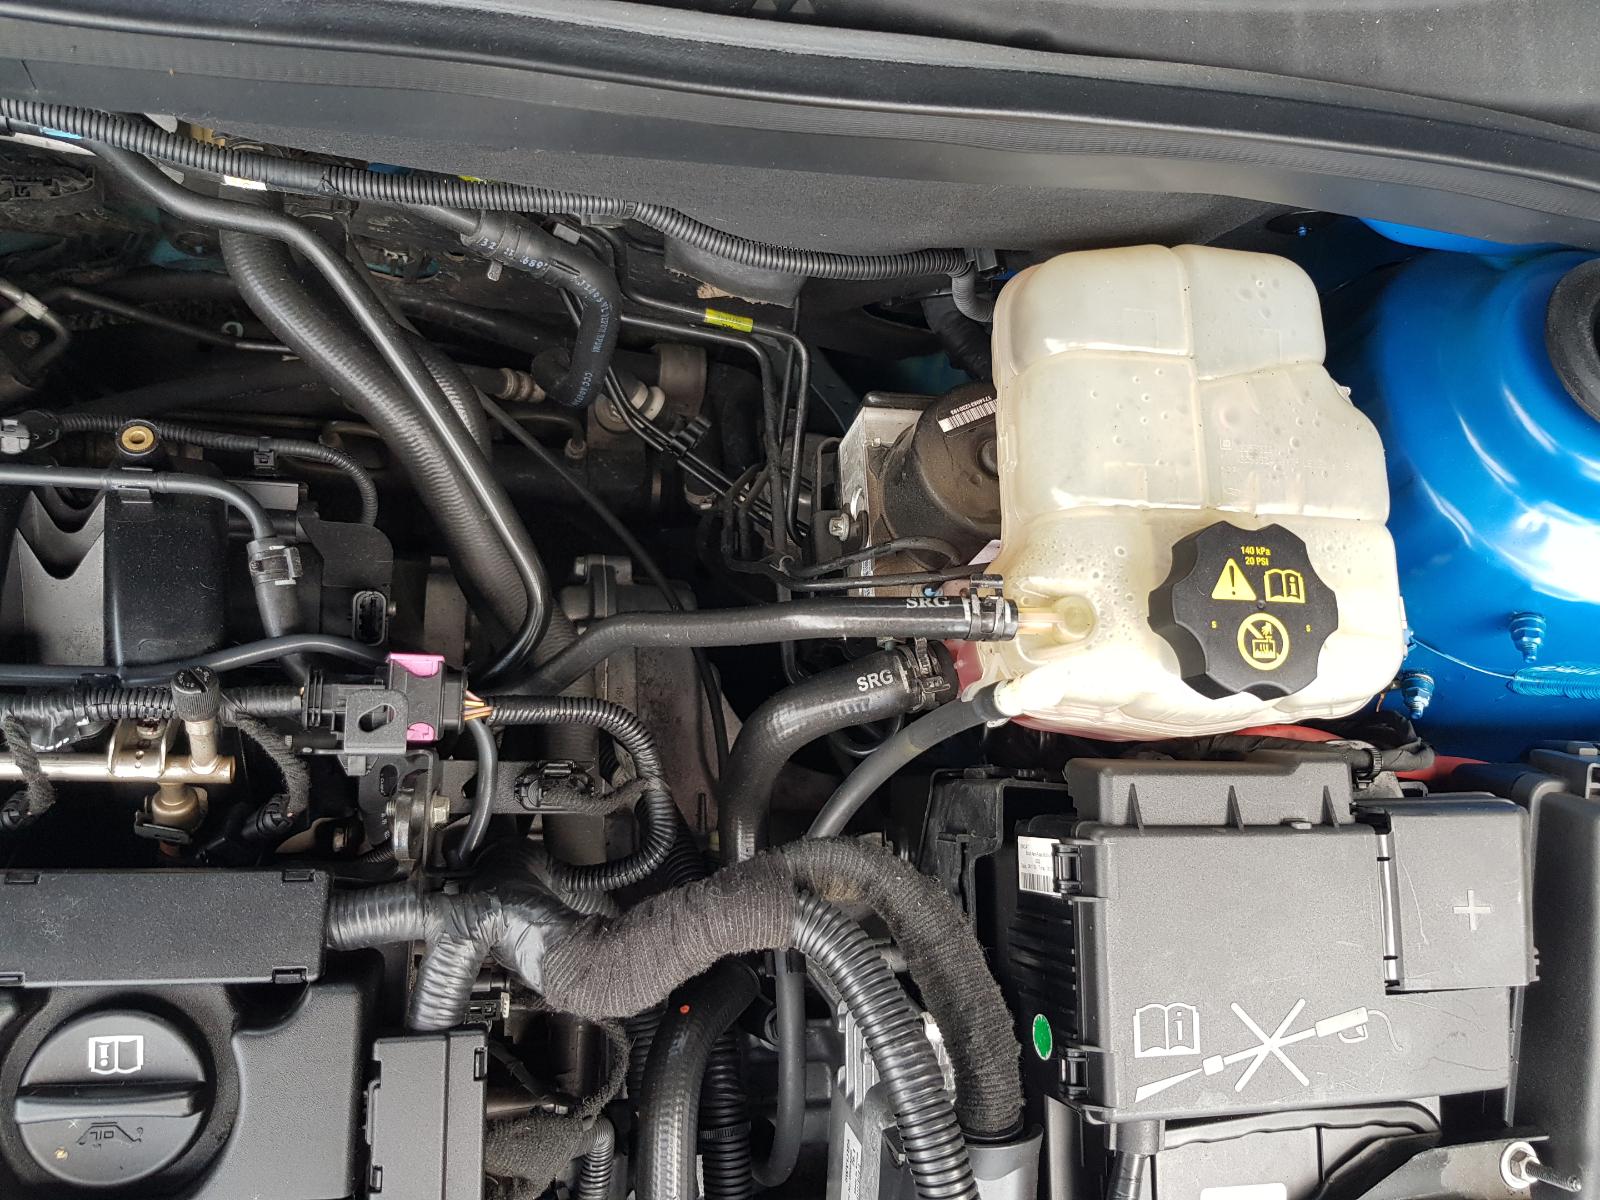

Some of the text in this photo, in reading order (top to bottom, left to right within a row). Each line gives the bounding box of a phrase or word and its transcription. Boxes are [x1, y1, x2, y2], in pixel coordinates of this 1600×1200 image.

[1240, 546, 1271, 556] 140 kPa
[1245, 556, 1269, 566] 20 PSI
[906, 597, 950, 609] SRG
[856, 669, 894, 692] SRG
